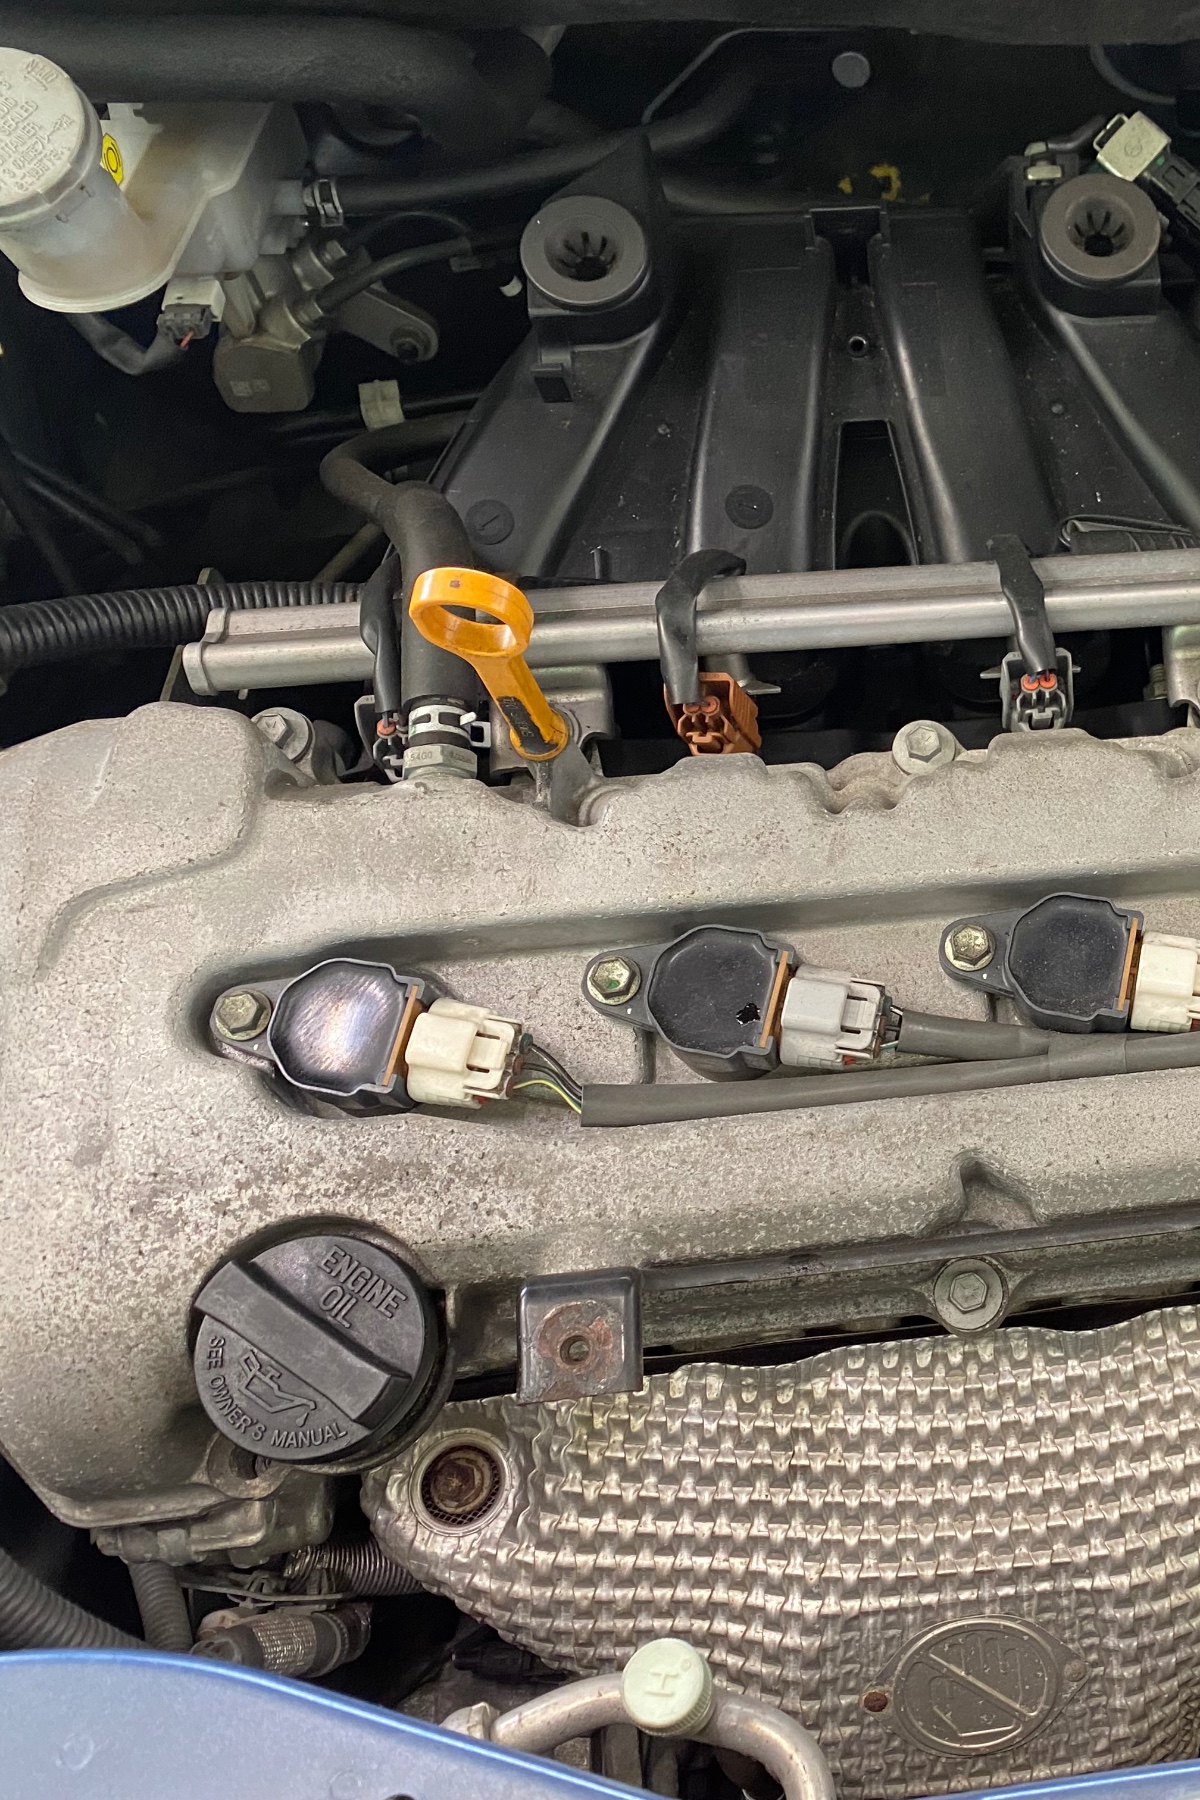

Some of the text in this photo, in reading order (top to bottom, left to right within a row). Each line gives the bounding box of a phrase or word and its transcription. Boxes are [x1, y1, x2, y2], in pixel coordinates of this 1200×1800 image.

[0, 97, 18, 118] UID
[0, 121, 42, 165] NTAINER
[317, 1244, 408, 1320] ENGINE
[318, 1285, 353, 1330] OIL
[206, 1334, 348, 1449] SEE OWNER'S MANUAL
